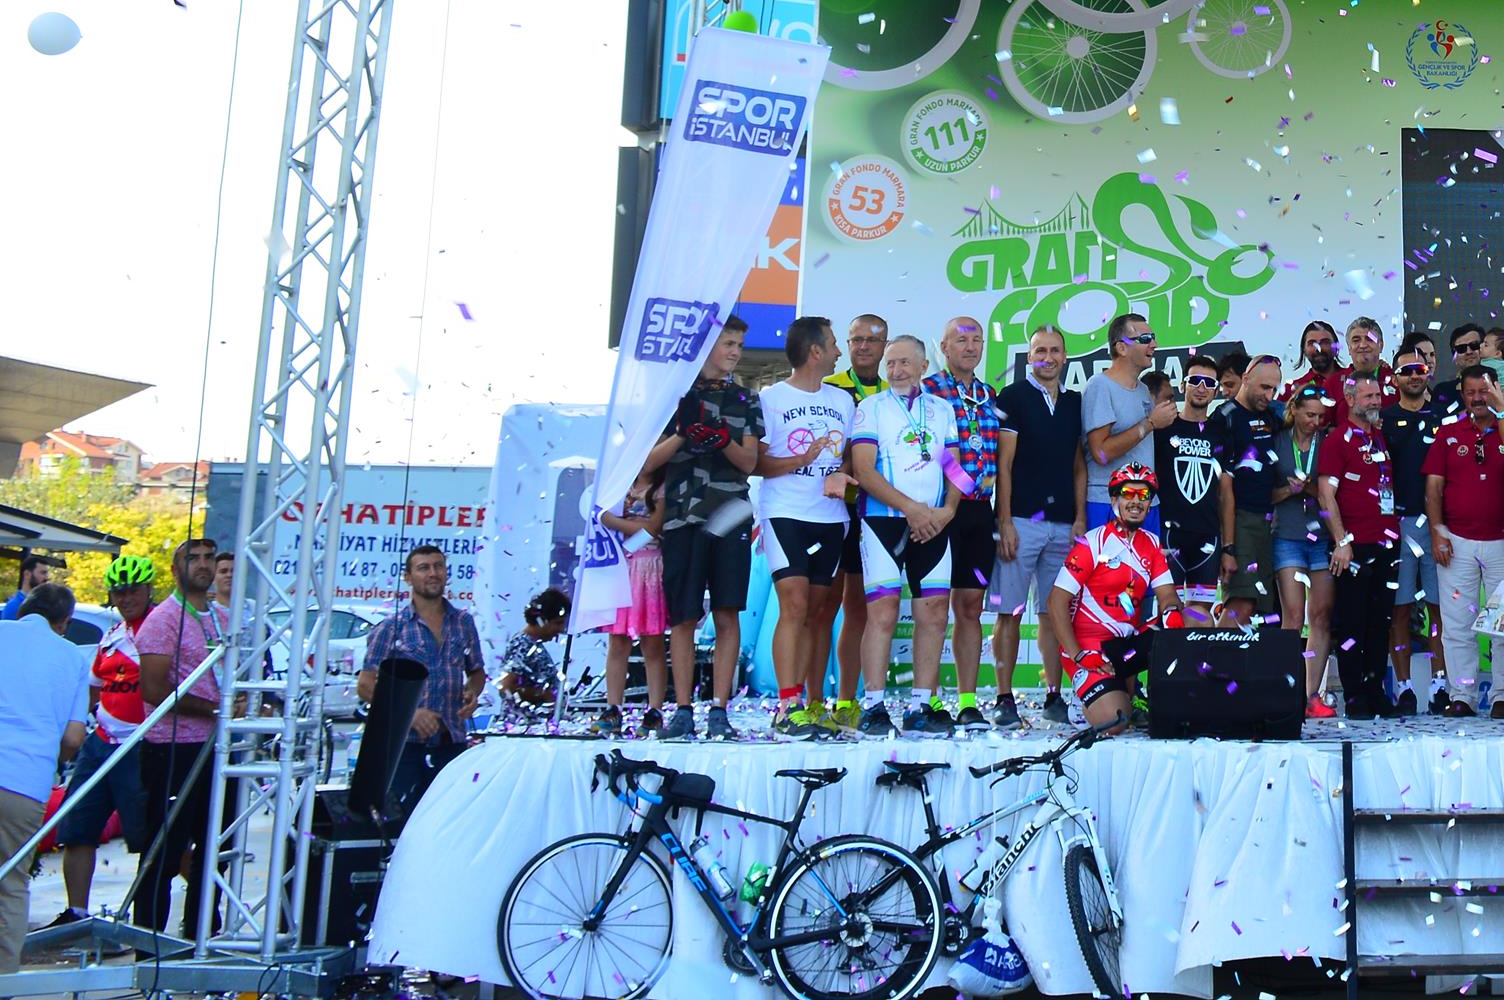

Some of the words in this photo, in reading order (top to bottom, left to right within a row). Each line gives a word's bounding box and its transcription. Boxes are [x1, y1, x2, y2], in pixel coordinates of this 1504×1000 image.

[695, 86, 797, 130] SPOR
[917, 98, 945, 121] FONDO
[923, 117, 970, 150] 111
[950, 145, 982, 171] PARKUR
[833, 172, 851, 196] GRAN
[851, 163, 882, 176] FONDO
[882, 167, 905, 208] MARMARA
[848, 185, 886, 215] 53
[851, 226, 887, 240] PARKUR
[946, 230, 1117, 293] GRAN
[783, 406, 807, 424] NEW
[810, 406, 846, 425] SCHOOL
[1179, 446, 1211, 457] POWER
[1180, 438, 1211, 448] BEYOND
[361, 562, 378, 578] 87
[660, 832, 708, 892] CUBE
[979, 821, 1039, 898] Bianchi
